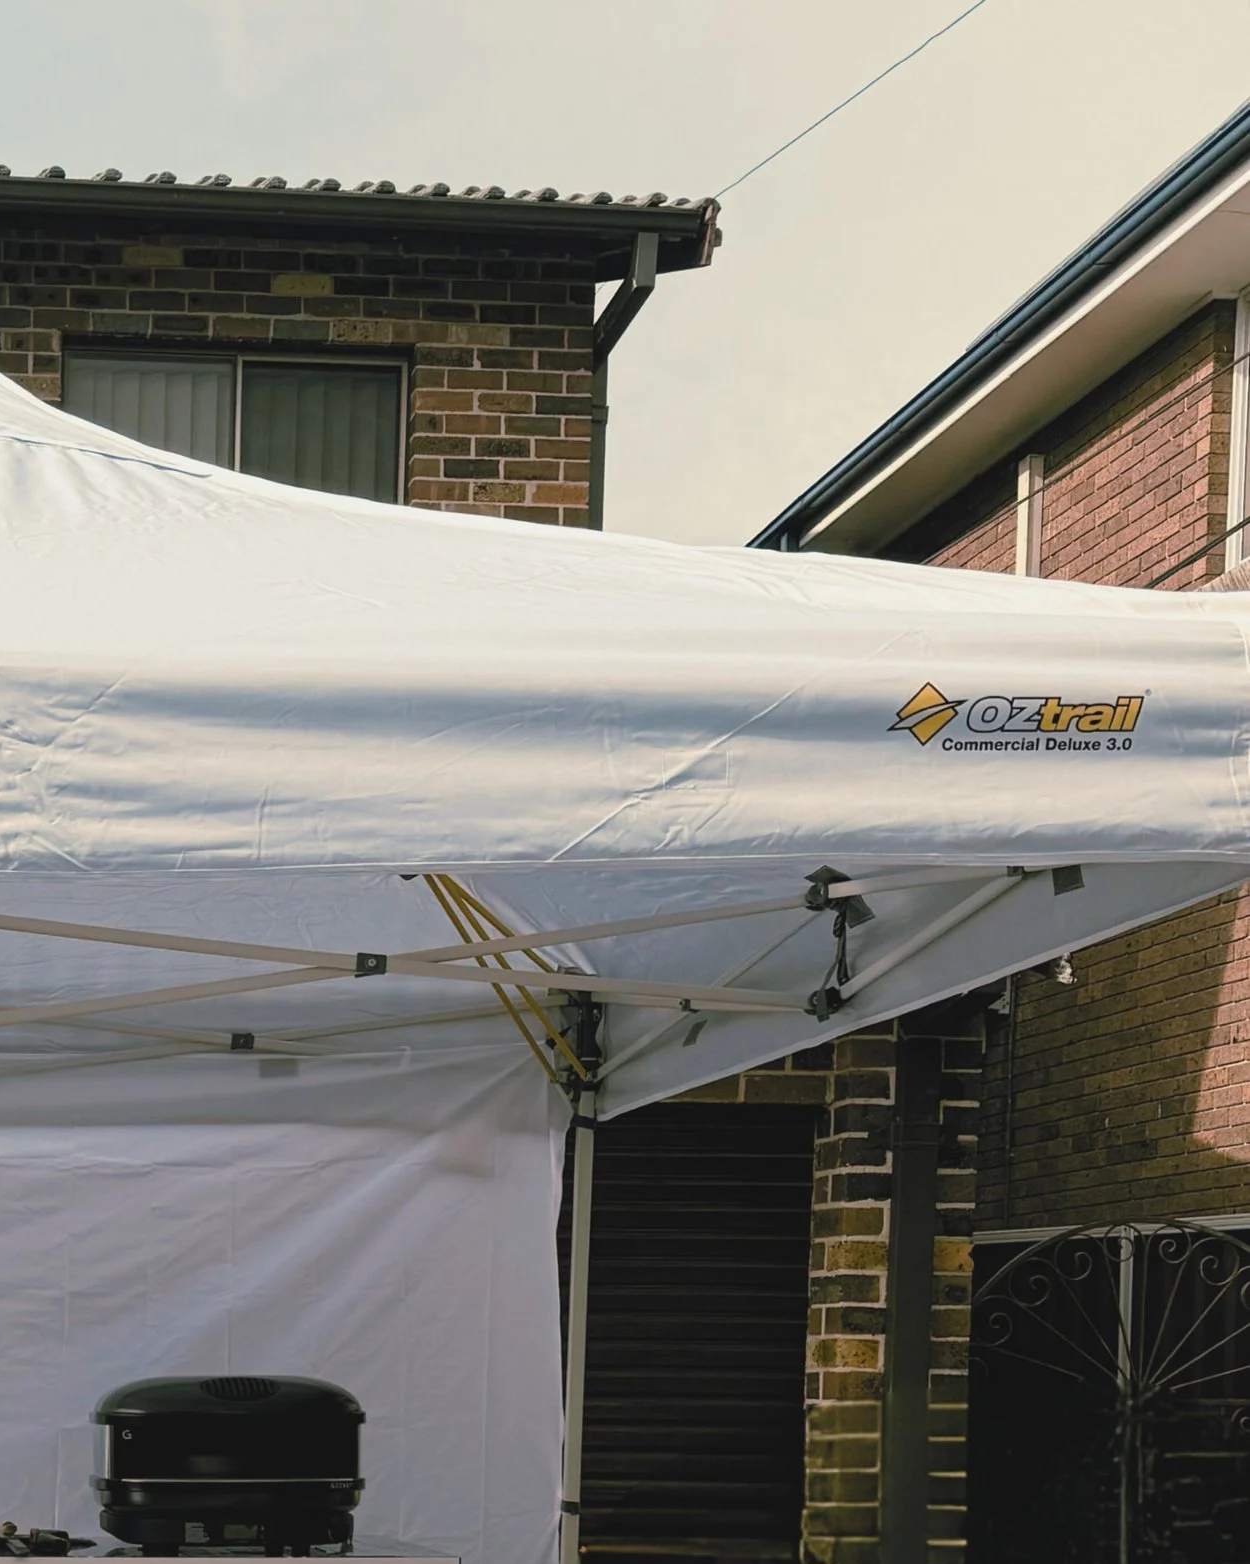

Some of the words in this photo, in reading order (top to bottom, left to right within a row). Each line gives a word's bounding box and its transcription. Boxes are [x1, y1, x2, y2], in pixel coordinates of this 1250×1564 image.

[967, 696, 1144, 733] OZtrail
[942, 738, 1039, 751] Commercial
[1046, 738, 1100, 751] Deluxe
[1106, 738, 1132, 751] 3.0
